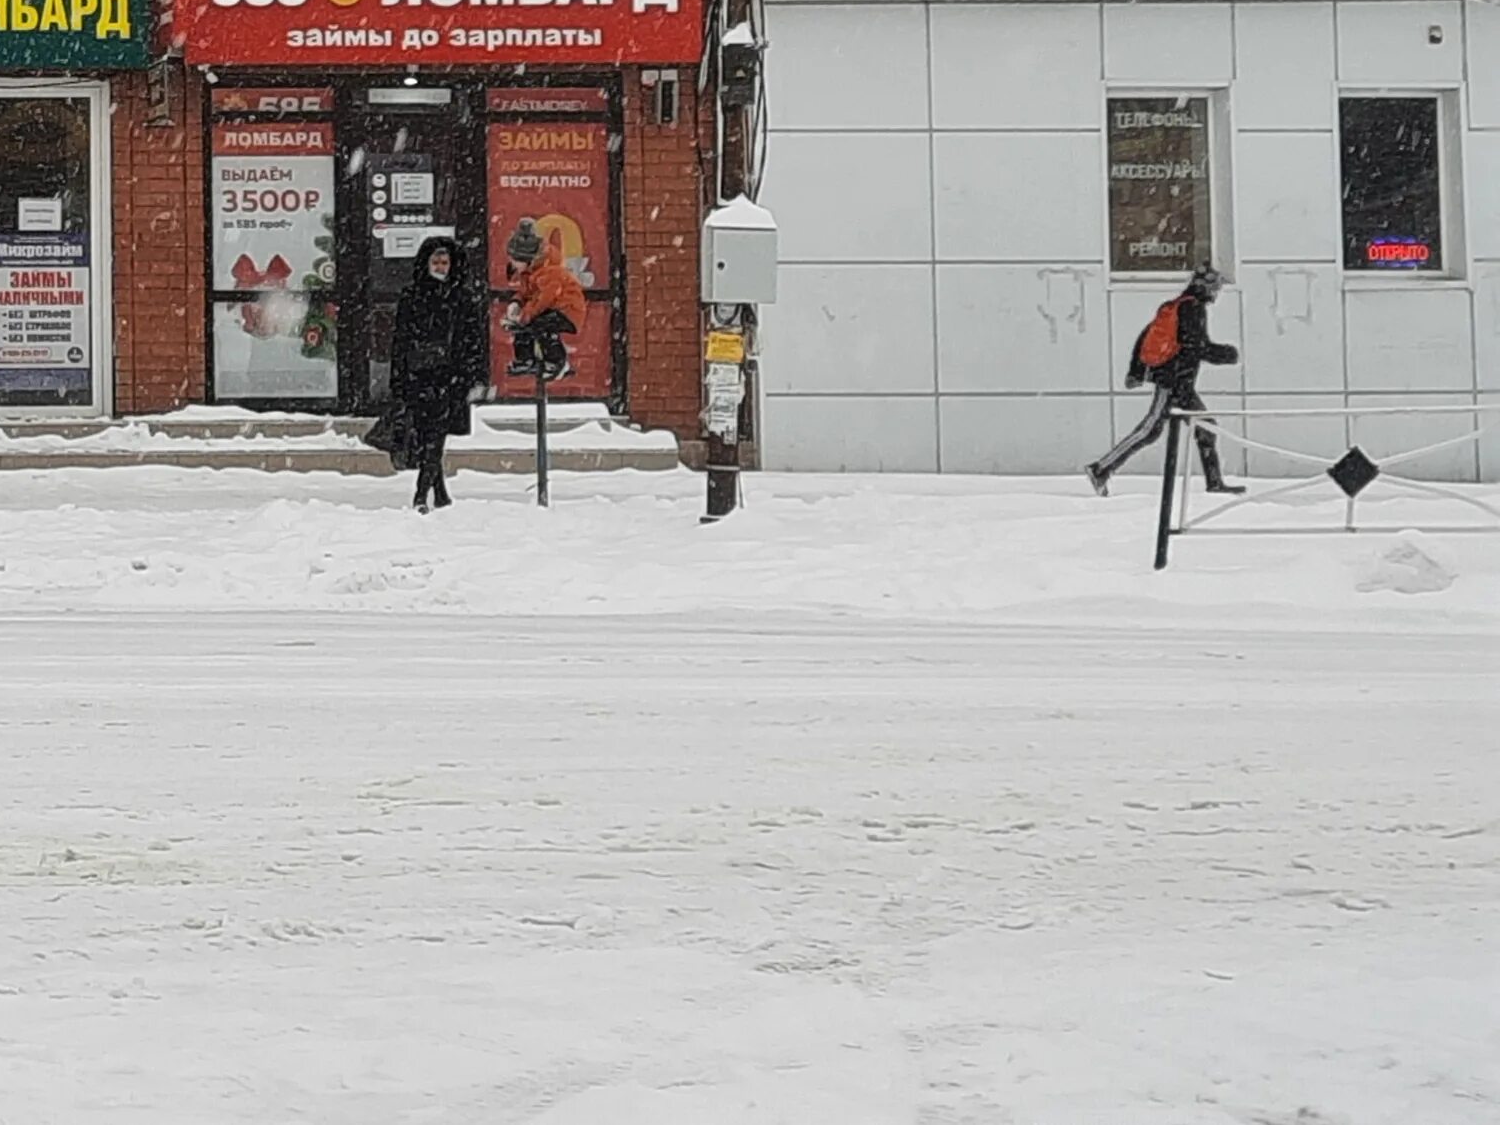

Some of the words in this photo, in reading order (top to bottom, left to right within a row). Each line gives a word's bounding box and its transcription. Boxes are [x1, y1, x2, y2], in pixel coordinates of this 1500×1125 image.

[286, 24, 393, 48] займы
[402, 29, 440, 51] до
[449, 29, 602, 51] зарплаты
[1115, 111, 1199, 128] ТЕЛЕФОНЫ
[223, 131, 324, 148] ЛОМБАРД
[499, 127, 594, 151] ЗАЙМЫ
[221, 165, 293, 182] ВЫДАЁМ
[500, 175, 591, 188] БЕСПЛАТНО
[221, 189, 320, 213] 3500₽
[1129, 241, 1187, 257] РЕМОНТ
[1368, 244, 1429, 261] ОТКРЫТО
[10, 270, 73, 288] ЗАЙМЫ
